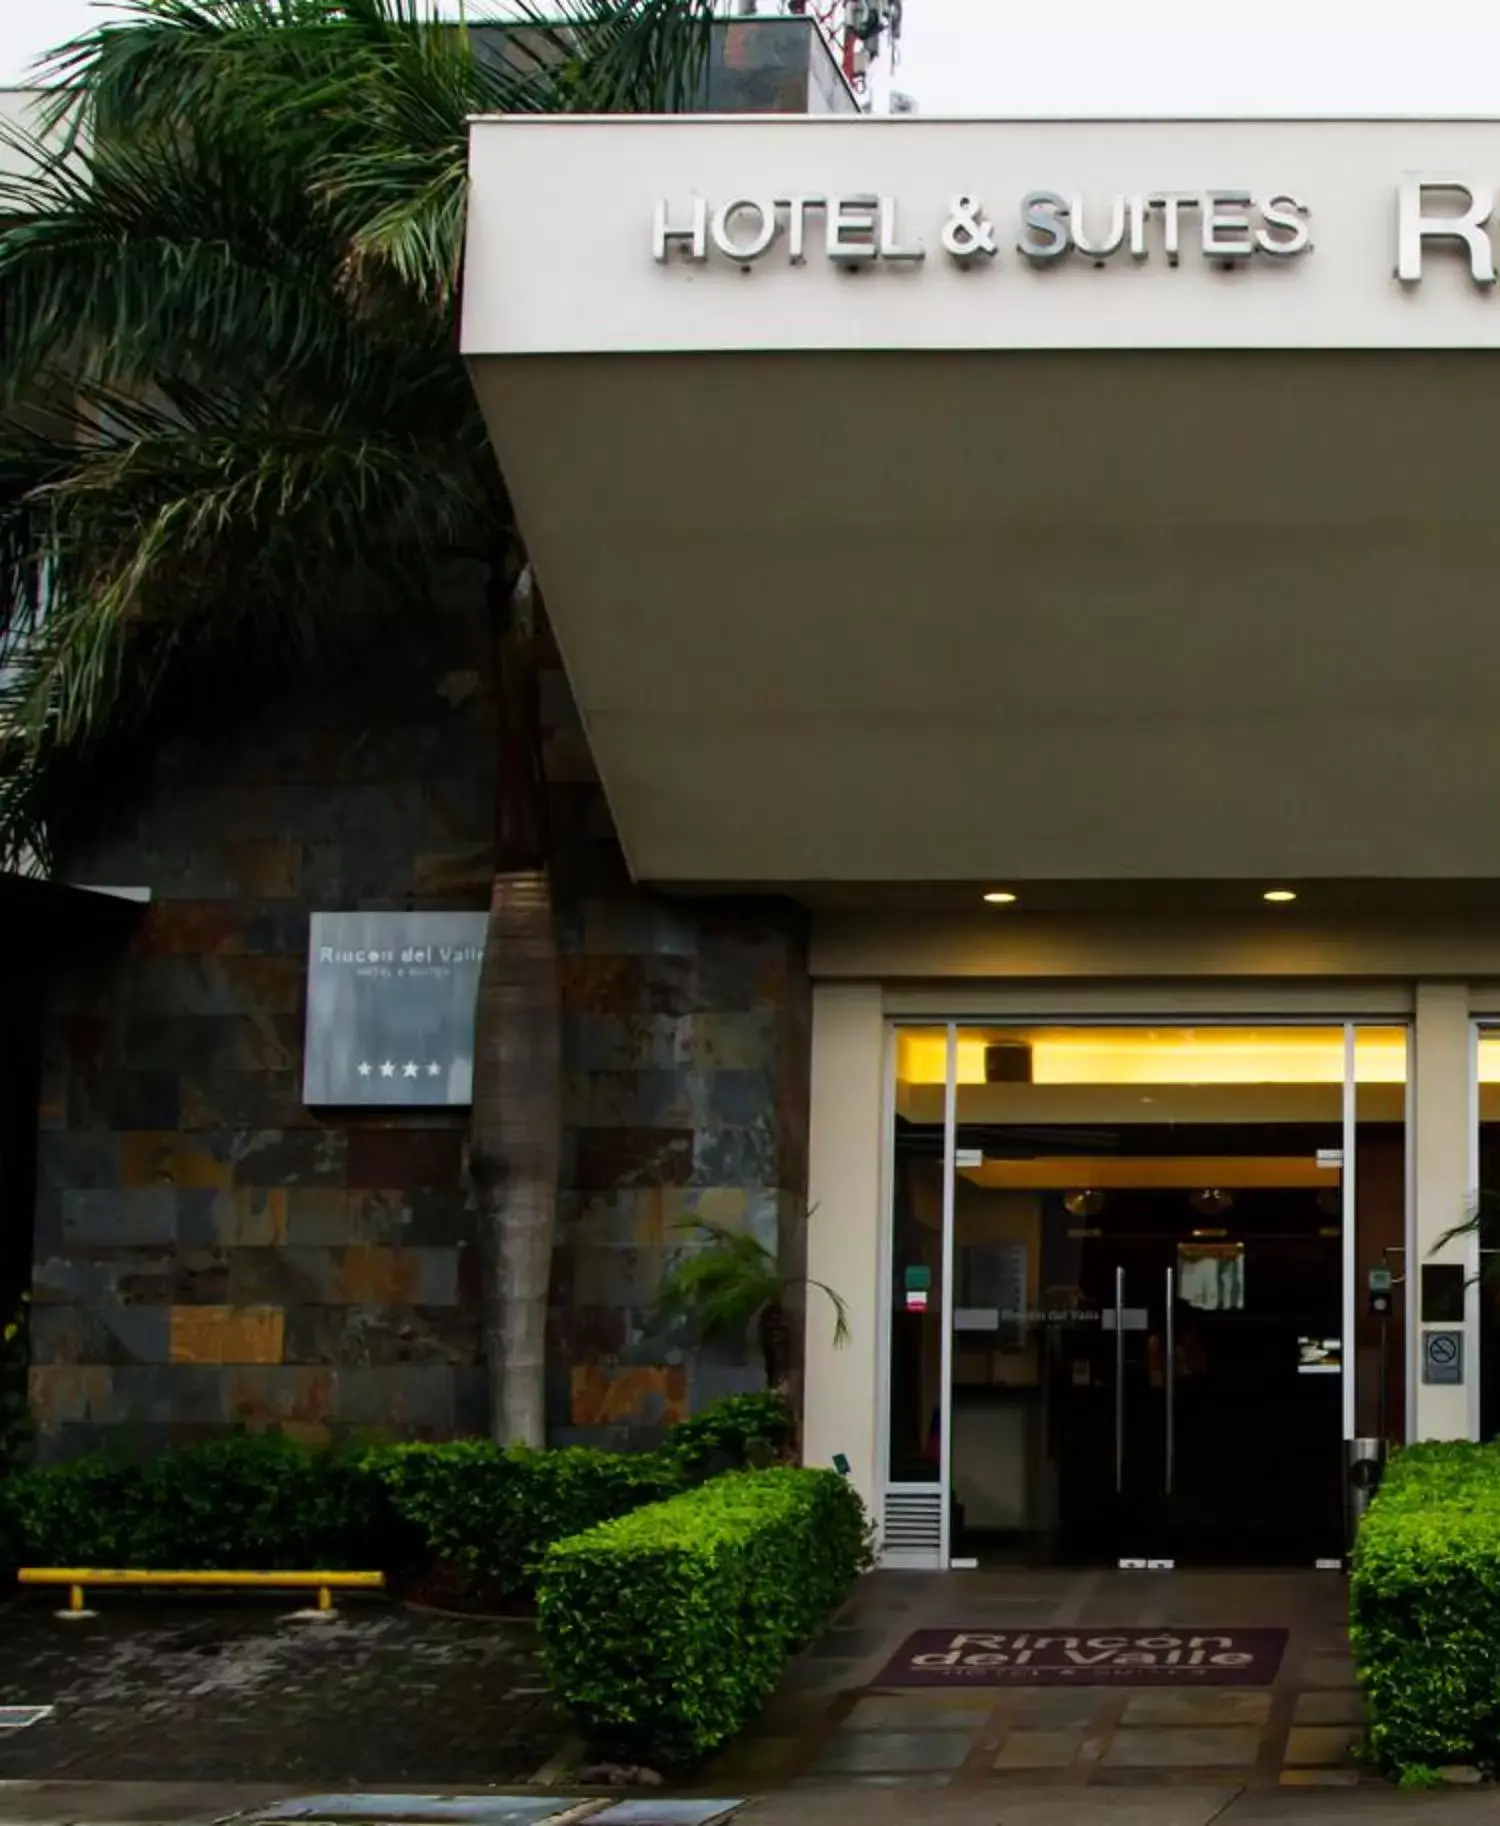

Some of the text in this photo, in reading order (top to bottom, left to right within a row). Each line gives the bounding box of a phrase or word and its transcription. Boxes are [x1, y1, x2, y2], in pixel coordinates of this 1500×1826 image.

[651, 190, 1311, 264] HOTEL & SUITES
[401, 945, 431, 963] del
[911, 1649, 1254, 1665] del Valle
